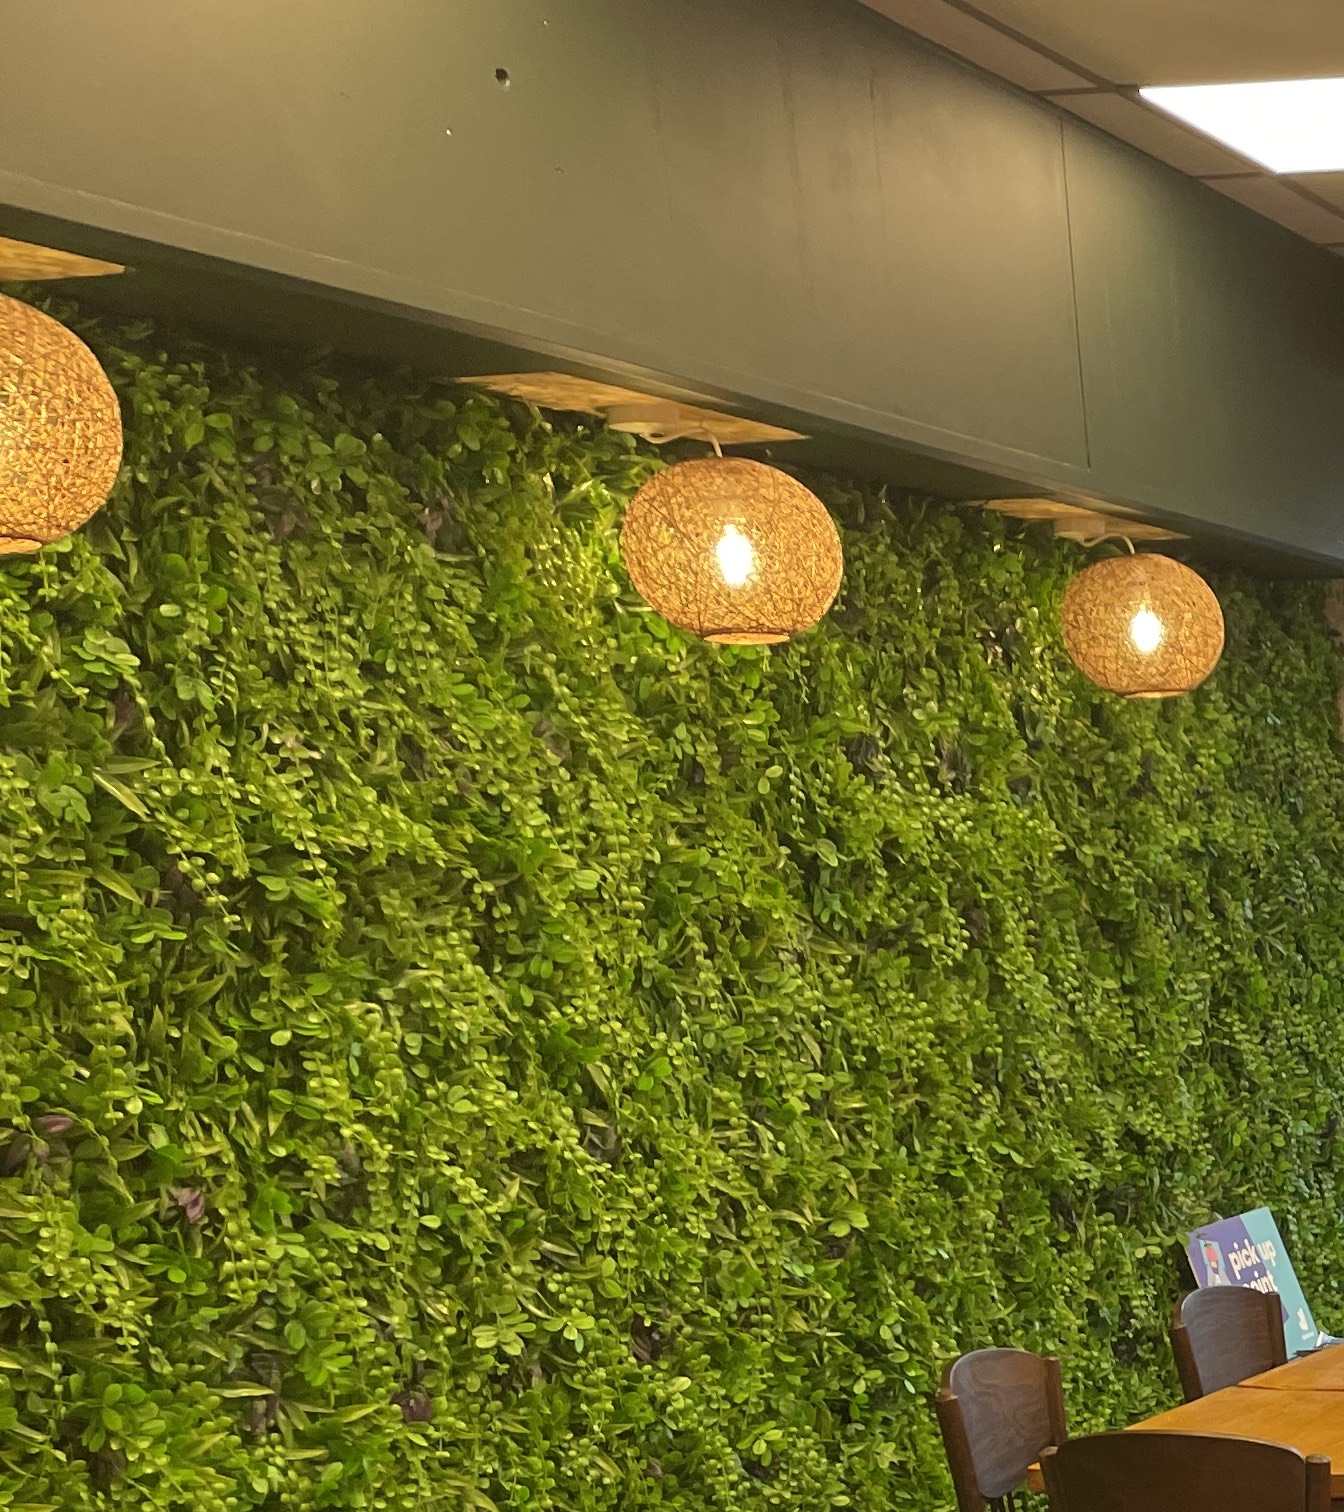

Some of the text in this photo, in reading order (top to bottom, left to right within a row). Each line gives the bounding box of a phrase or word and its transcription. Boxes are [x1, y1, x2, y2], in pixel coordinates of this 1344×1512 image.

[1228, 1238, 1277, 1280] pick up
[1242, 1270, 1278, 1294] oint
